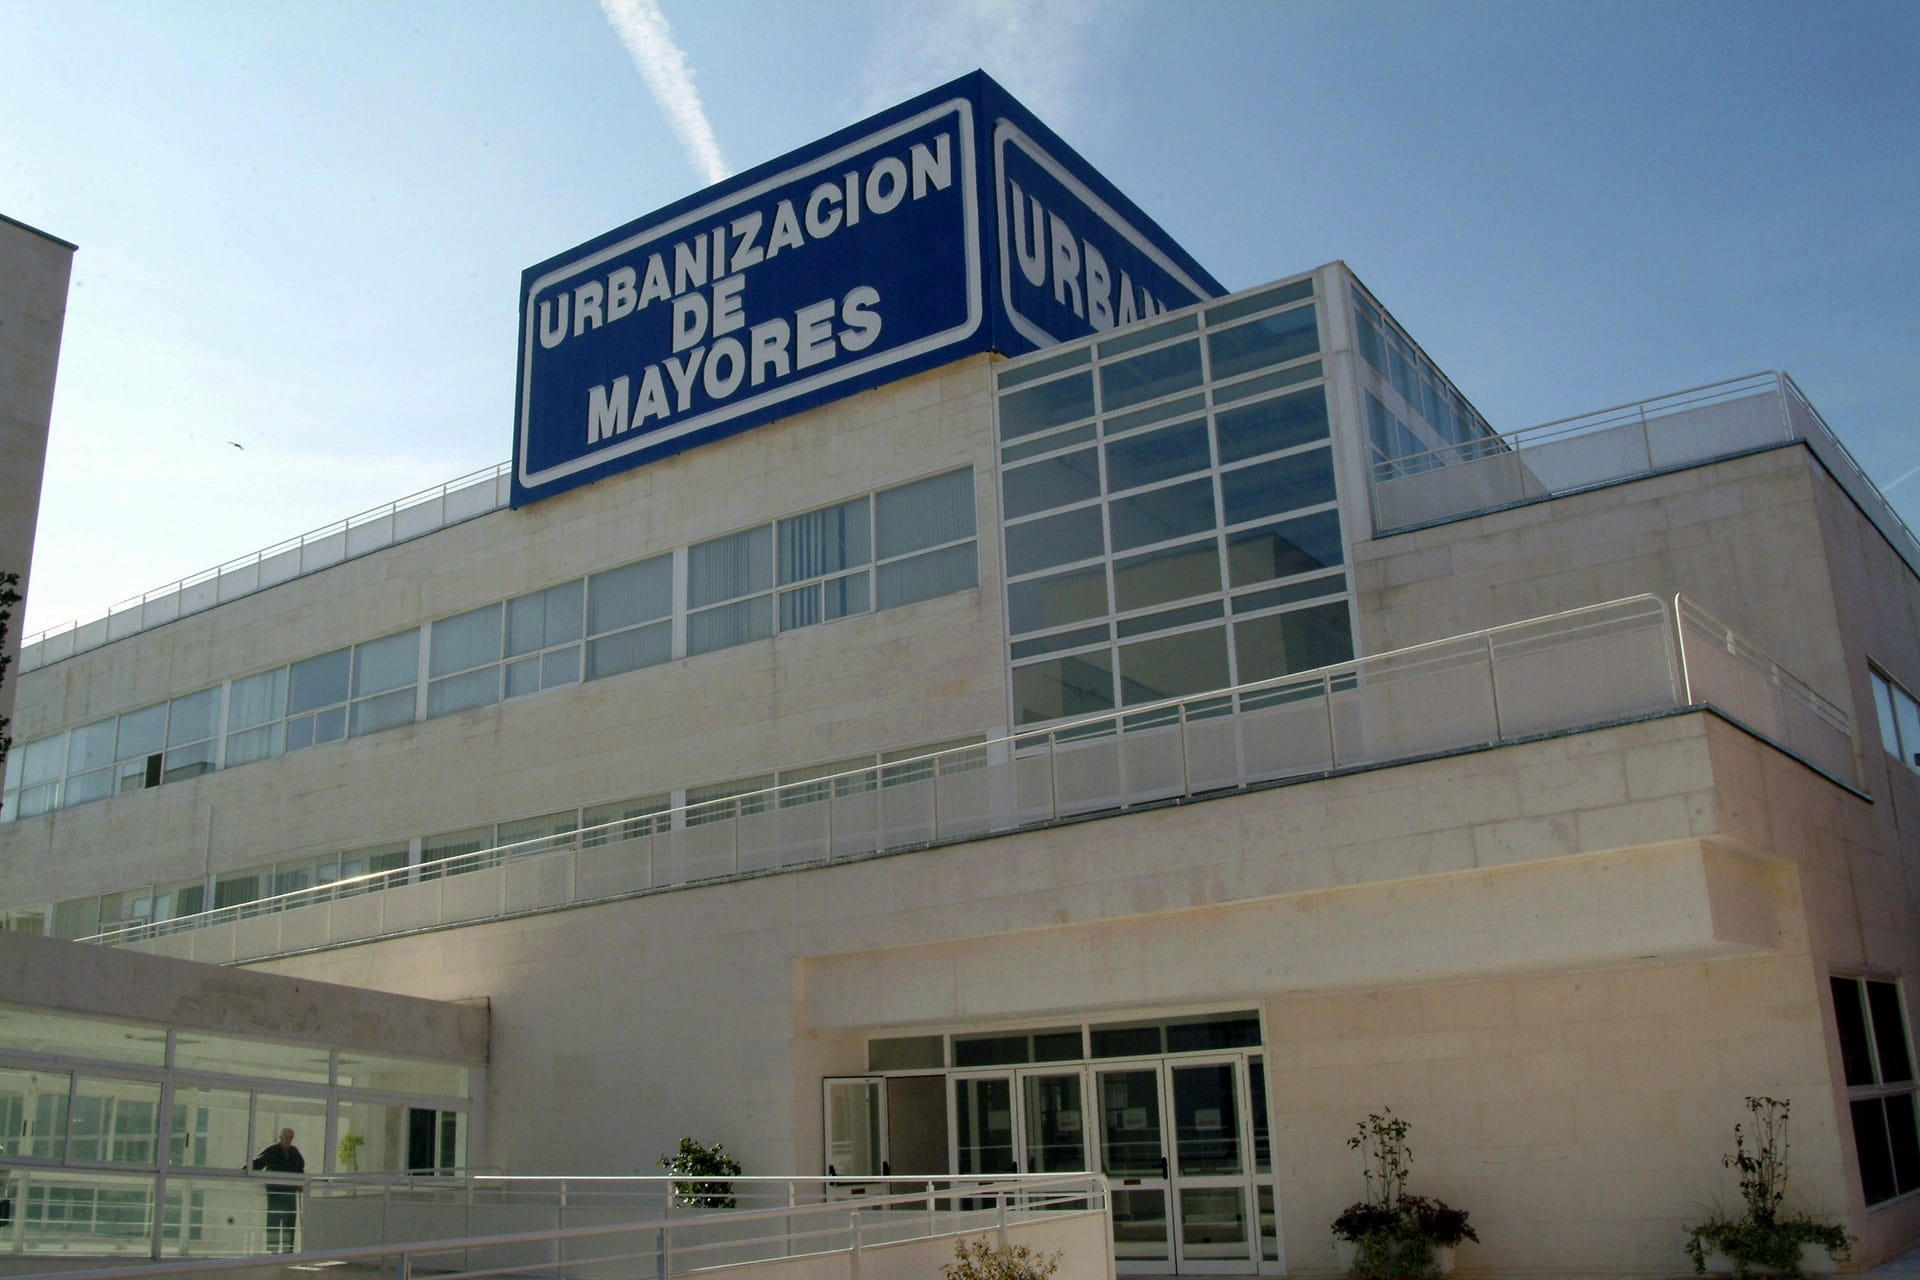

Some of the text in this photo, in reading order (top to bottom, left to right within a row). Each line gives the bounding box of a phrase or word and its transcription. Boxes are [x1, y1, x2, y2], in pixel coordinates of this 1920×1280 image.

[539, 132, 953, 349] URBANIZACION
[671, 273, 746, 354] DE
[586, 285, 883, 445] MAYORES
